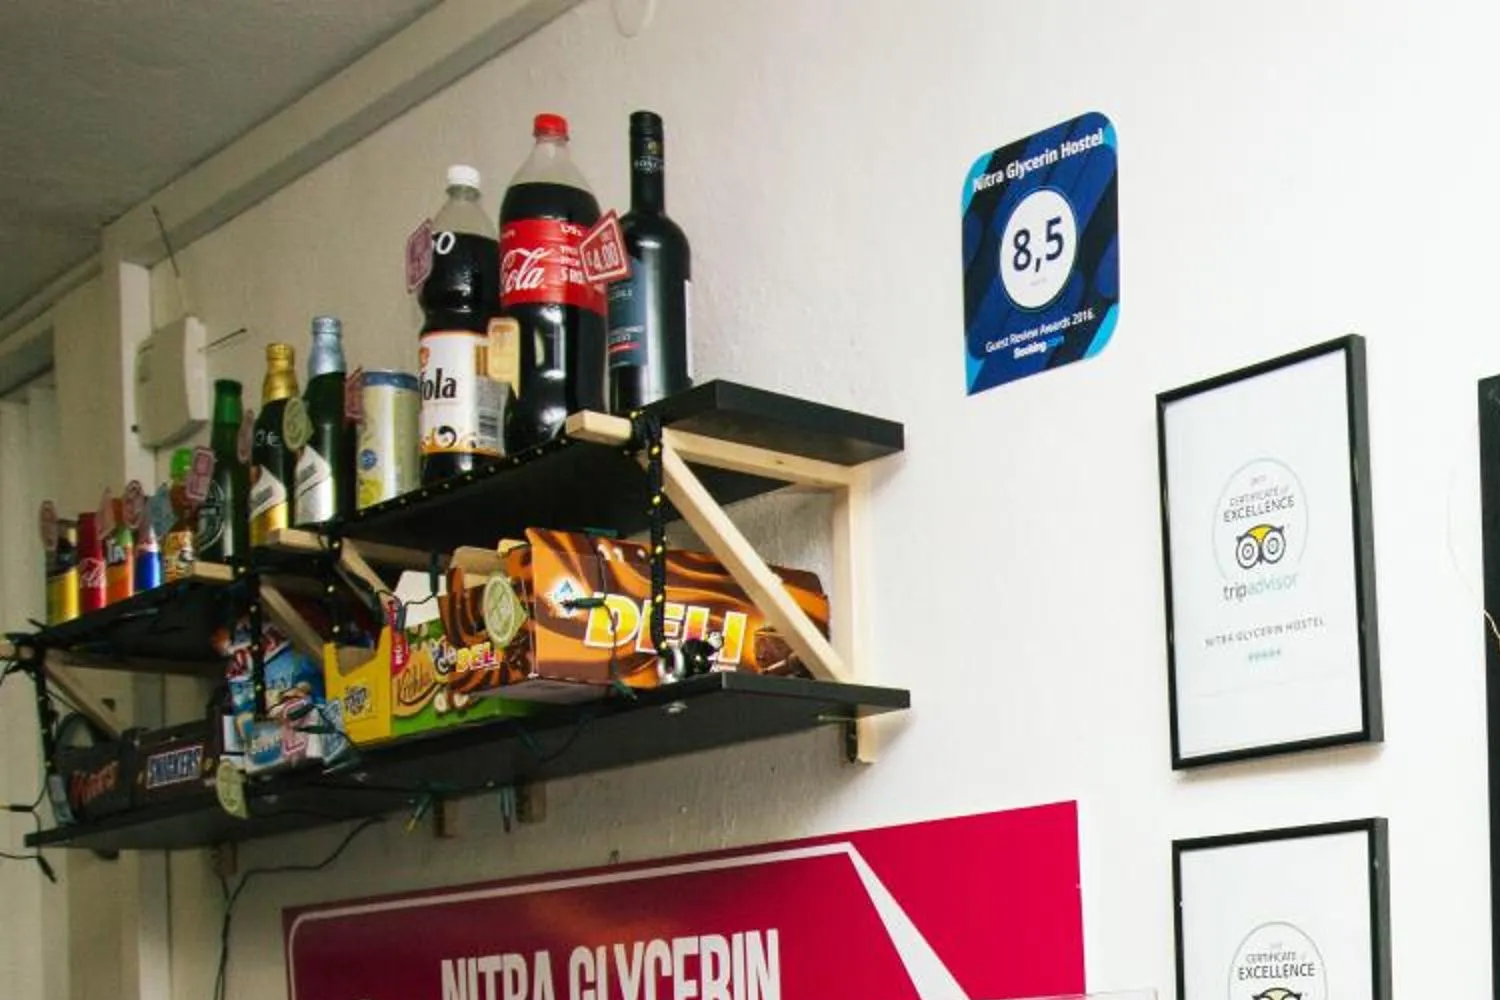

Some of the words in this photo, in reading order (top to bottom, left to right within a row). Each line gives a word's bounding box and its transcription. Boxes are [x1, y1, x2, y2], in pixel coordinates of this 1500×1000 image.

[972, 168, 1004, 192] Nitra
[1005, 148, 1059, 180] Glycerin
[1060, 127, 1105, 156] Hostel
[1012, 216, 1065, 272] 8,5
[985, 339, 1009, 353] Guest
[1009, 328, 1039, 346] Review
[1223, 495, 1295, 523] EXCELLENCE
[1223, 574, 1298, 602] tripadvisor
[1286, 616, 1326, 632] HOSTEL
[1238, 963, 1316, 981] EXCELLENCE
